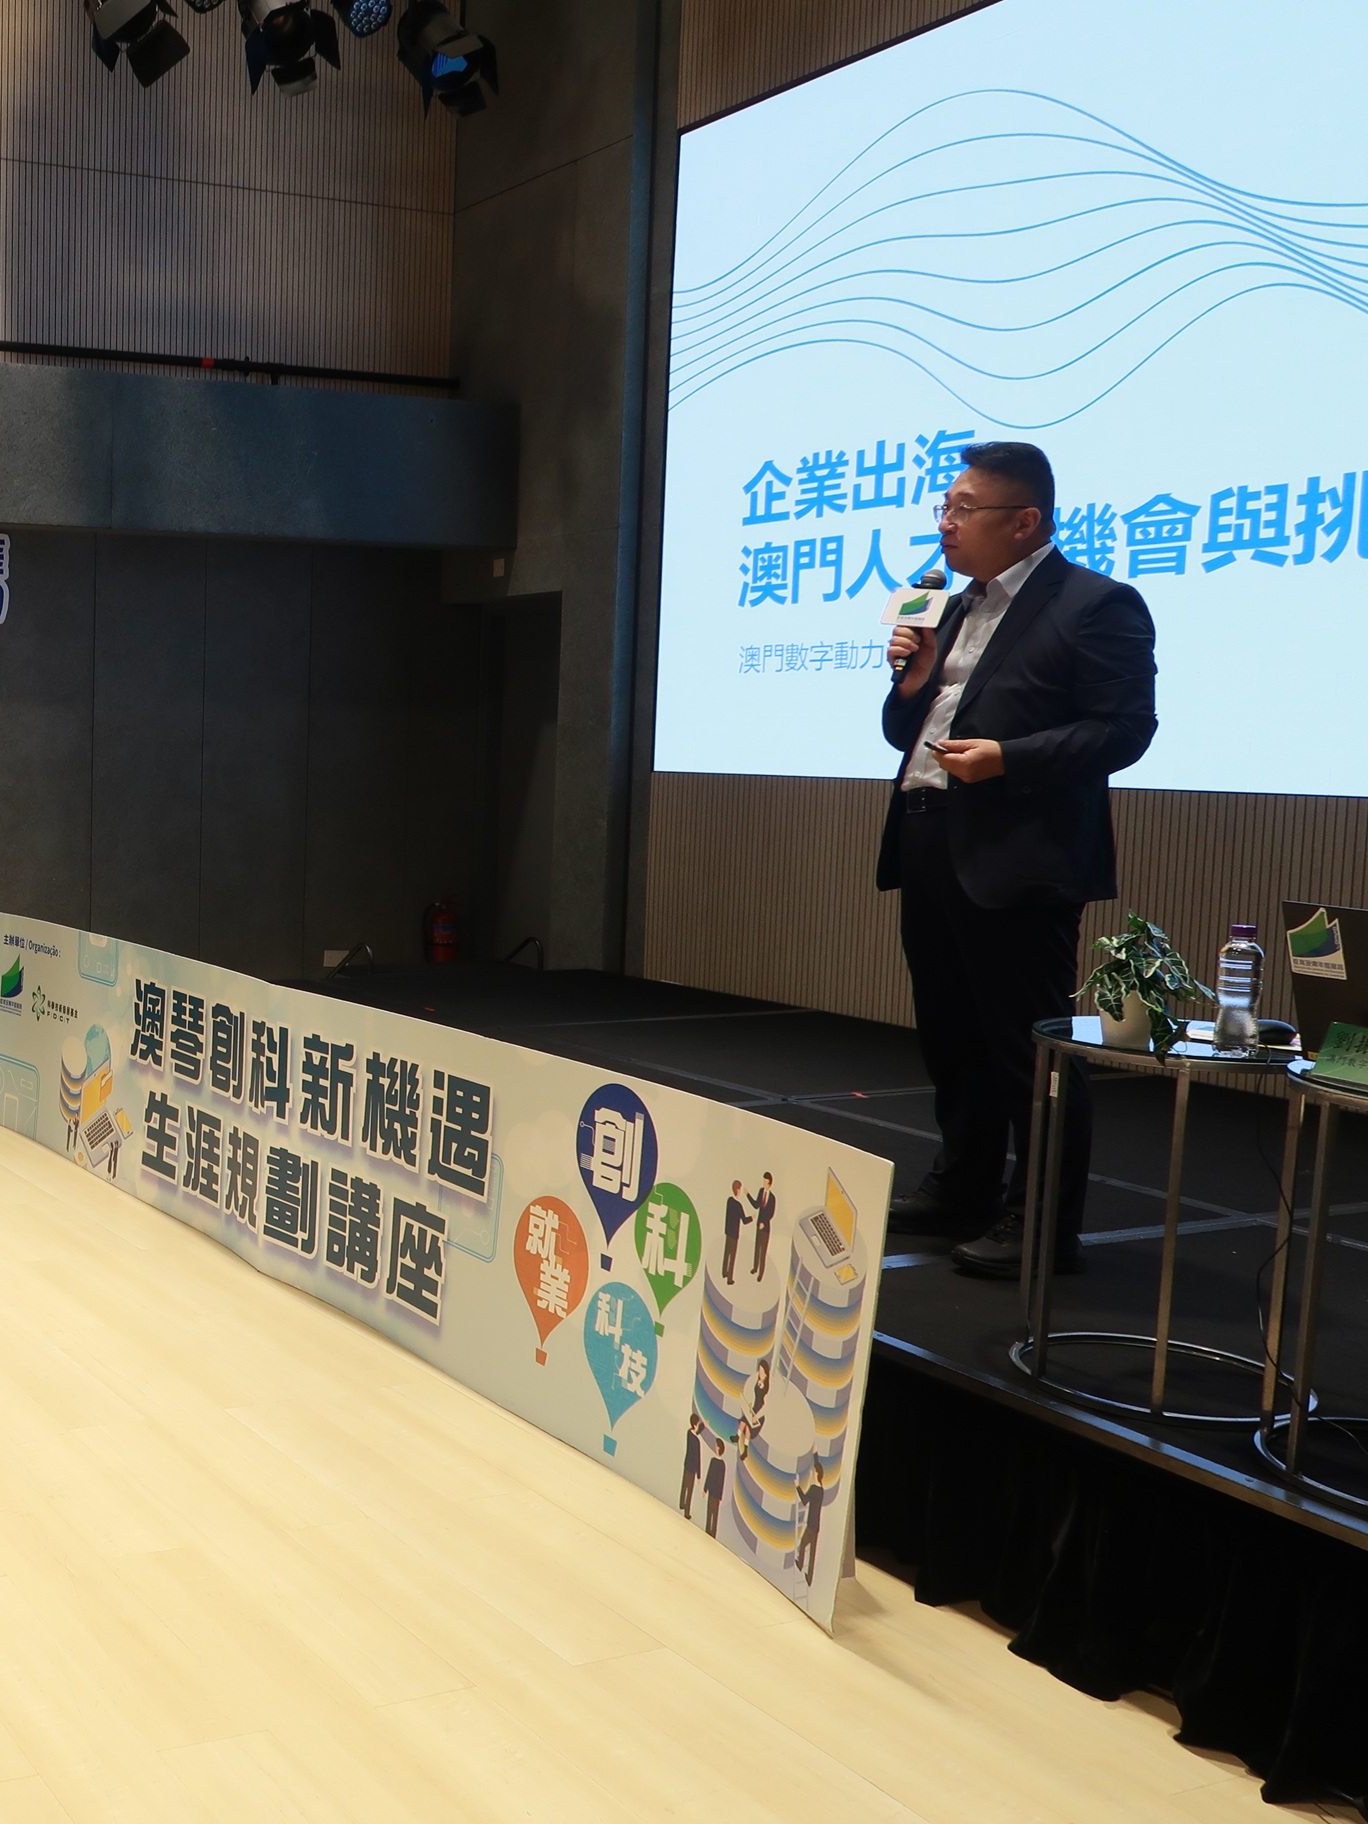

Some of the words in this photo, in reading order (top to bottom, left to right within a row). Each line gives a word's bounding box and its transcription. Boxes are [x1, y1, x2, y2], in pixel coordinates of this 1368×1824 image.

[741, 429, 975, 527] 企業出海
[738, 639, 891, 674] 澳門數字動力
[130, 978, 493, 1197] 澳琴創科新機遇
[593, 1107, 645, 1202] 創
[140, 1089, 447, 1320] 生涯規劃講座
[641, 1196, 690, 1288] 科
